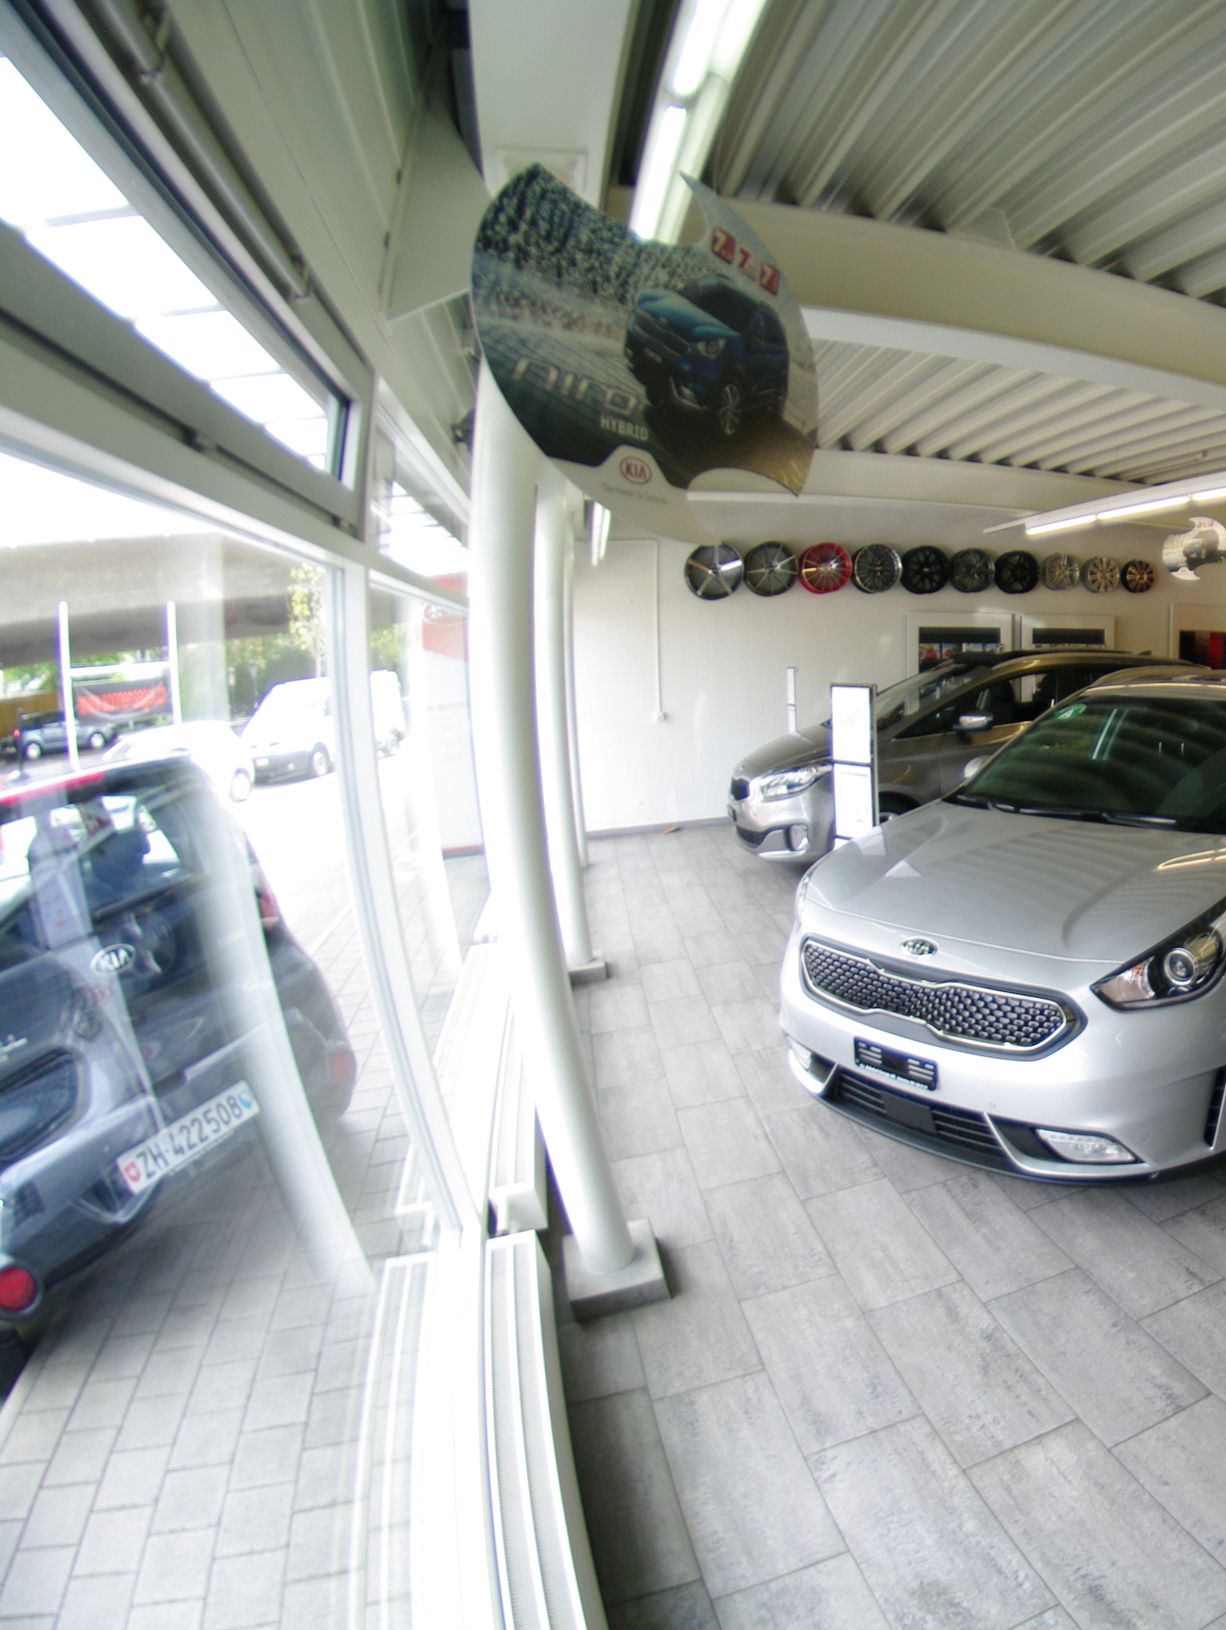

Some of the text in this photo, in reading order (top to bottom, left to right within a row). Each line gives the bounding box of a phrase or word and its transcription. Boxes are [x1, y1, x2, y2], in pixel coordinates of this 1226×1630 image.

[600, 413, 649, 443] HYBRID
[623, 459, 648, 481] KIA
[97, 947, 130, 968] KIA
